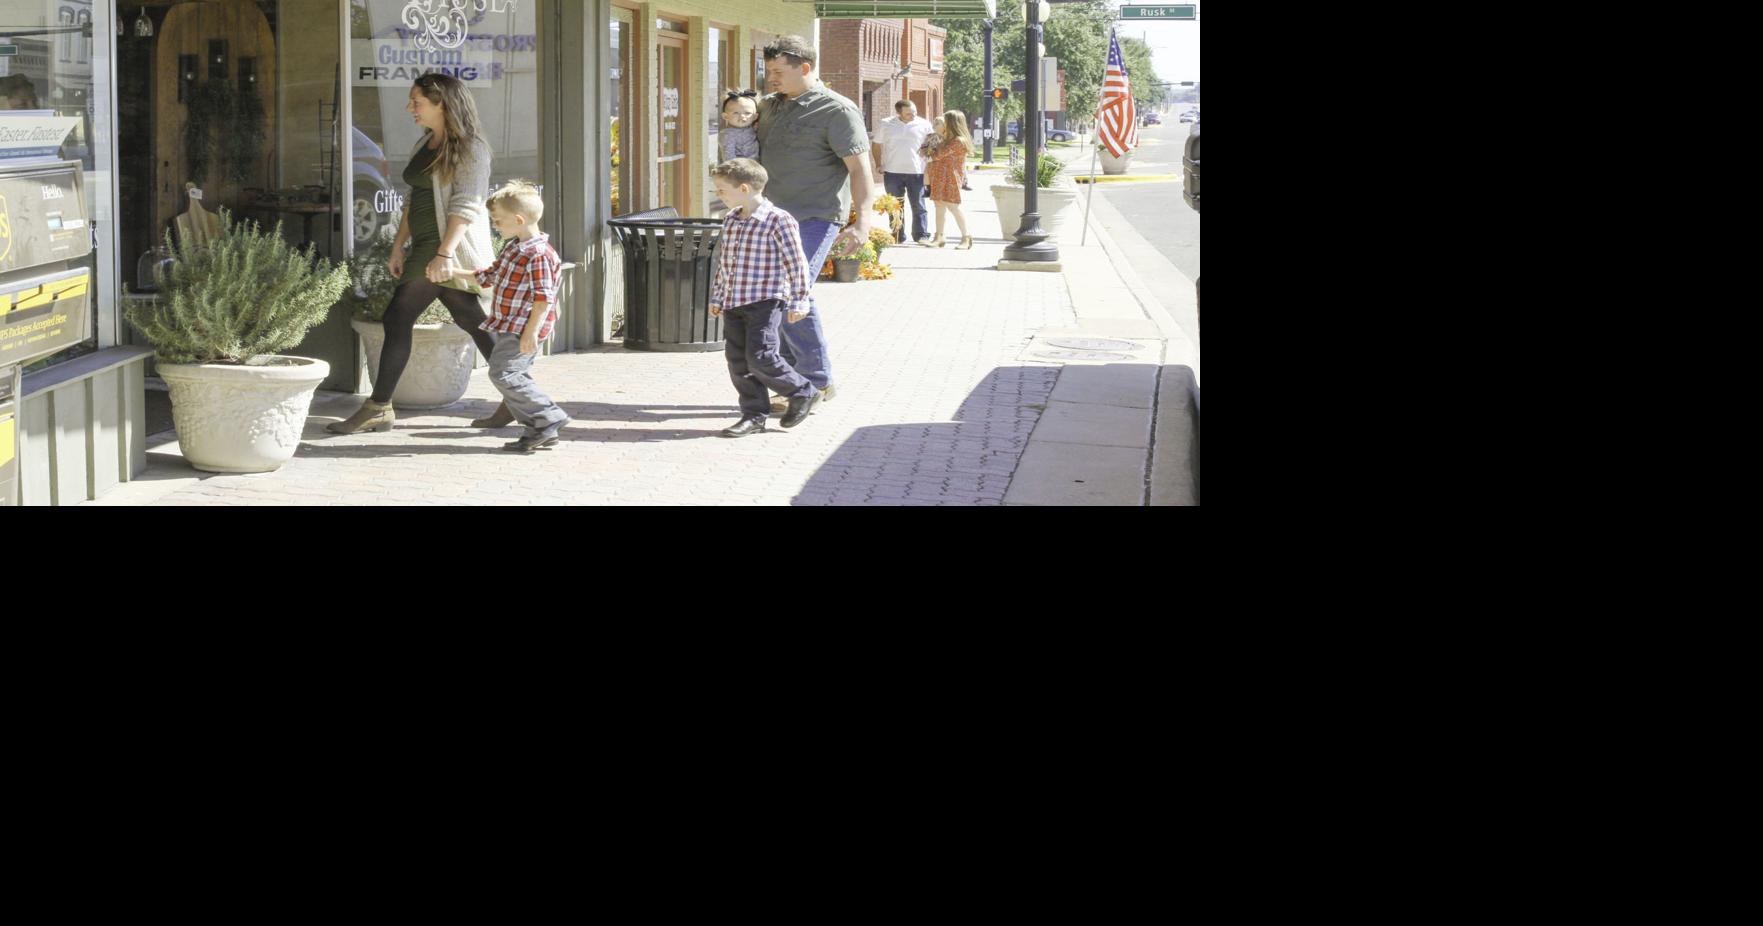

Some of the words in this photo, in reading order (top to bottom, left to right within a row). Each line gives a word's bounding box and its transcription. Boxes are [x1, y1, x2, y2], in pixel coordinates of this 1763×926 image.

[1140, 8, 1166, 16] Rusk
[379, 44, 462, 66] Custom
[359, 67, 479, 81] FRAMING
[374, 188, 403, 214] Gifts
